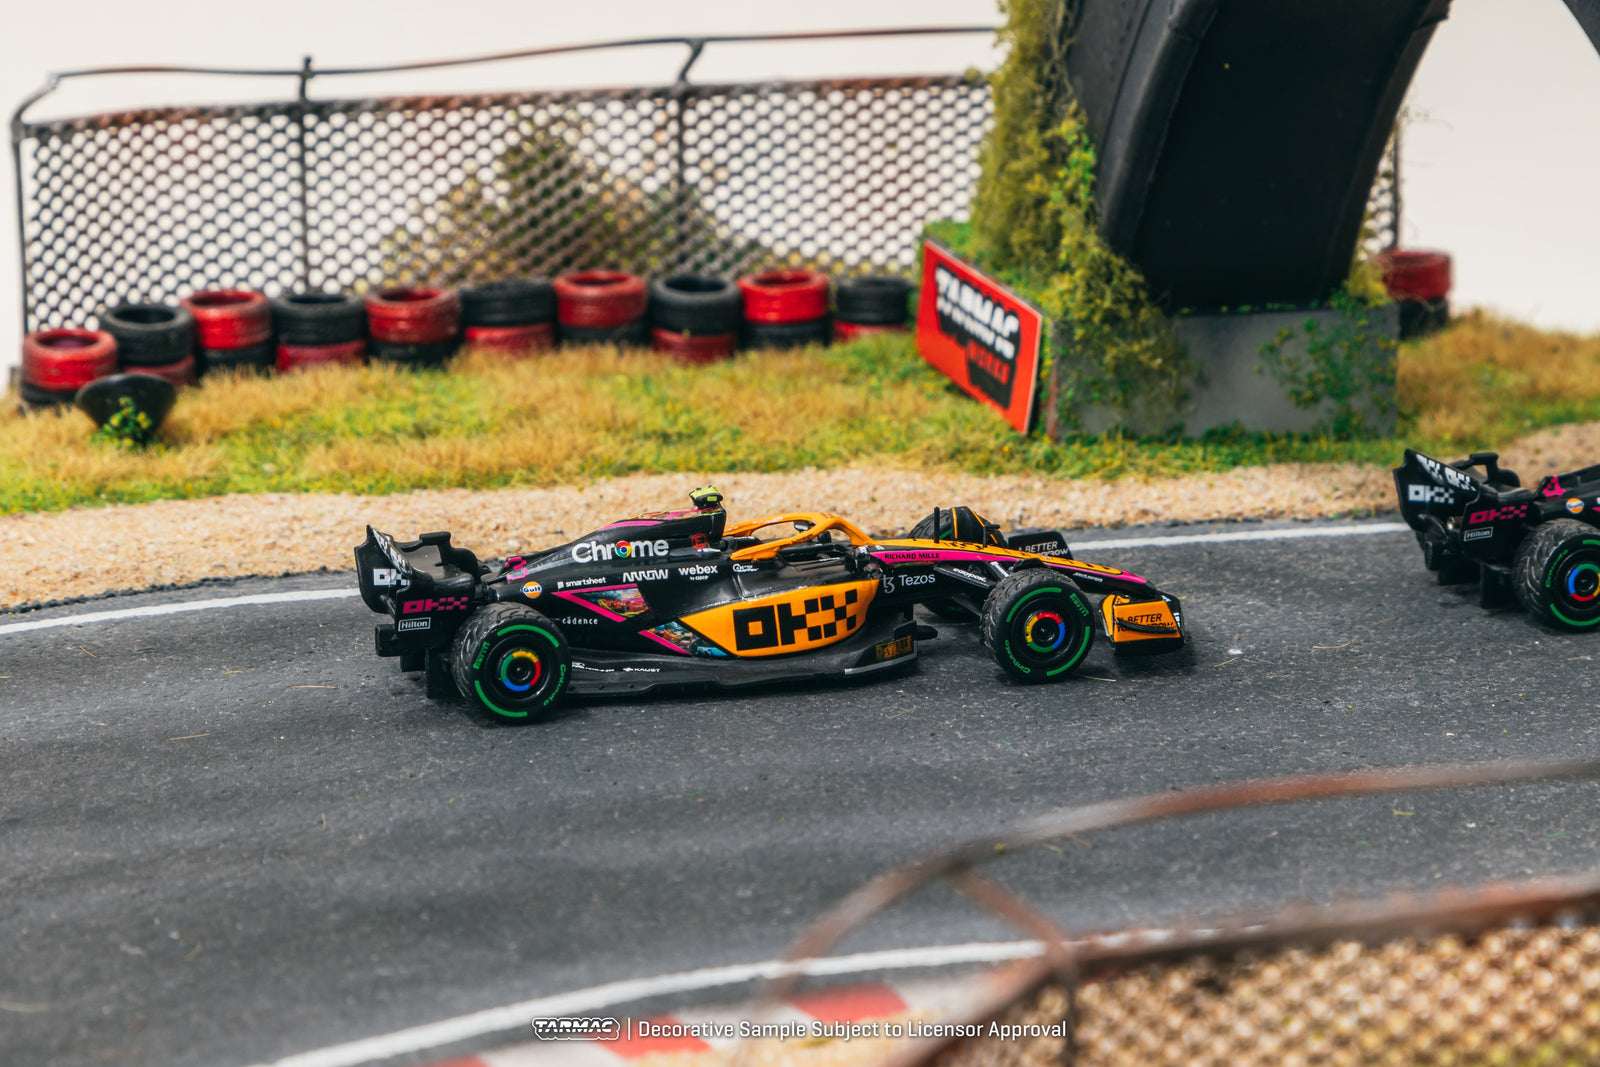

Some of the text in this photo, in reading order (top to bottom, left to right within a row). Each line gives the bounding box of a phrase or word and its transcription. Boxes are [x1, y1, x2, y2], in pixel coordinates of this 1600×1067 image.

[1469, 505, 1528, 524] OKX
[1466, 529, 1491, 539] Hilton
[572, 539, 669, 563] Chrome
[1025, 540, 1058, 553] BETTER
[622, 568, 669, 583] ARROW
[678, 564, 719, 576] webex
[565, 577, 607, 588] smartsheet
[898, 573, 936, 587] Tezos
[402, 597, 469, 614] OKX
[401, 620, 428, 629] Hilton
[733, 588, 858, 651] OKX
